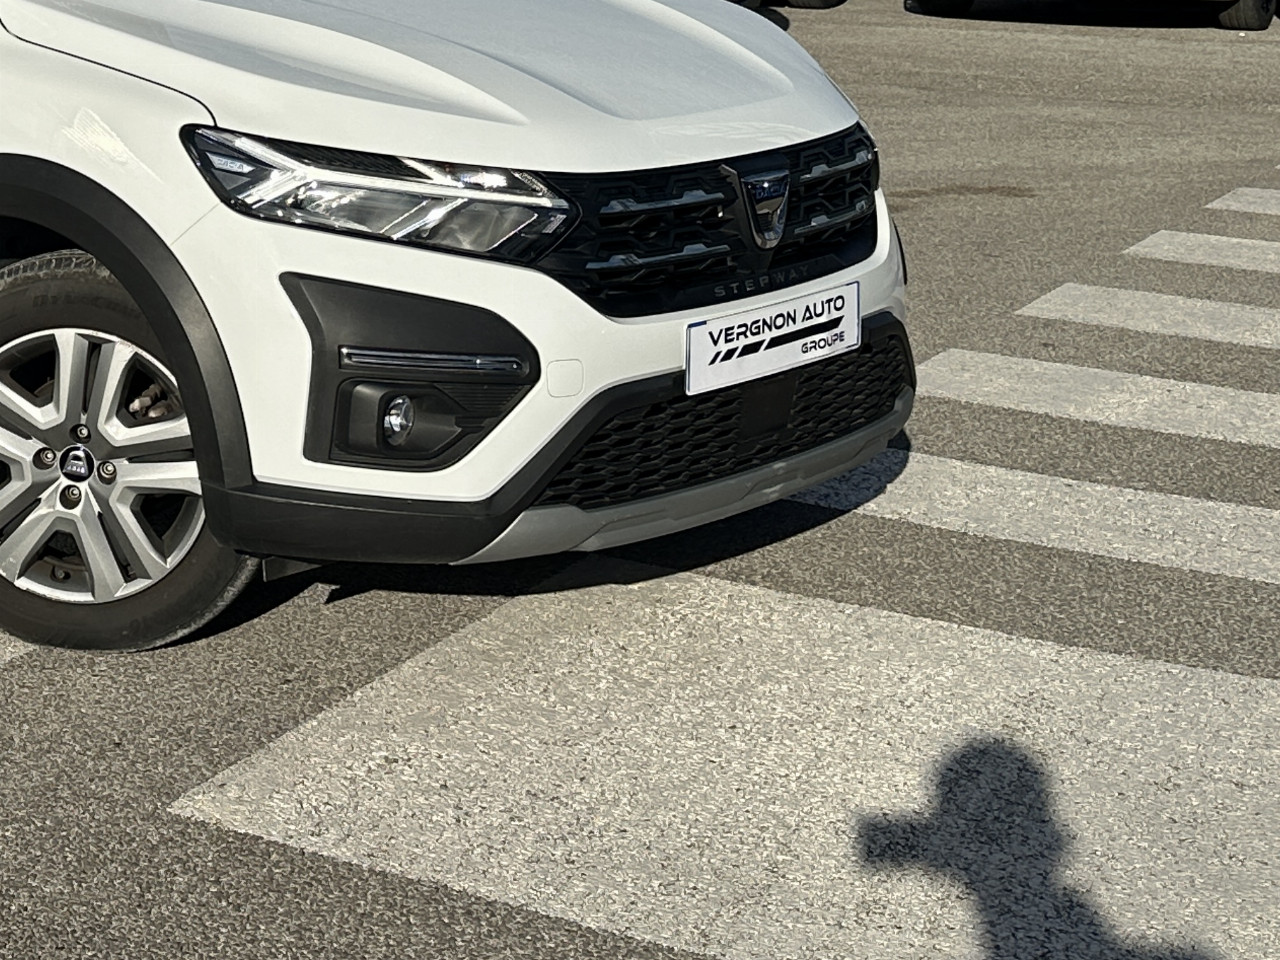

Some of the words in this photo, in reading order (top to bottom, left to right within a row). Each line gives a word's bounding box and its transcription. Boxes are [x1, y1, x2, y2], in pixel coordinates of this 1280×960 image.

[714, 265, 809, 298] STEPWAY
[708, 308, 797, 347] VERGNON
[801, 295, 846, 323] AUTO
[801, 331, 846, 354] GROUPE
